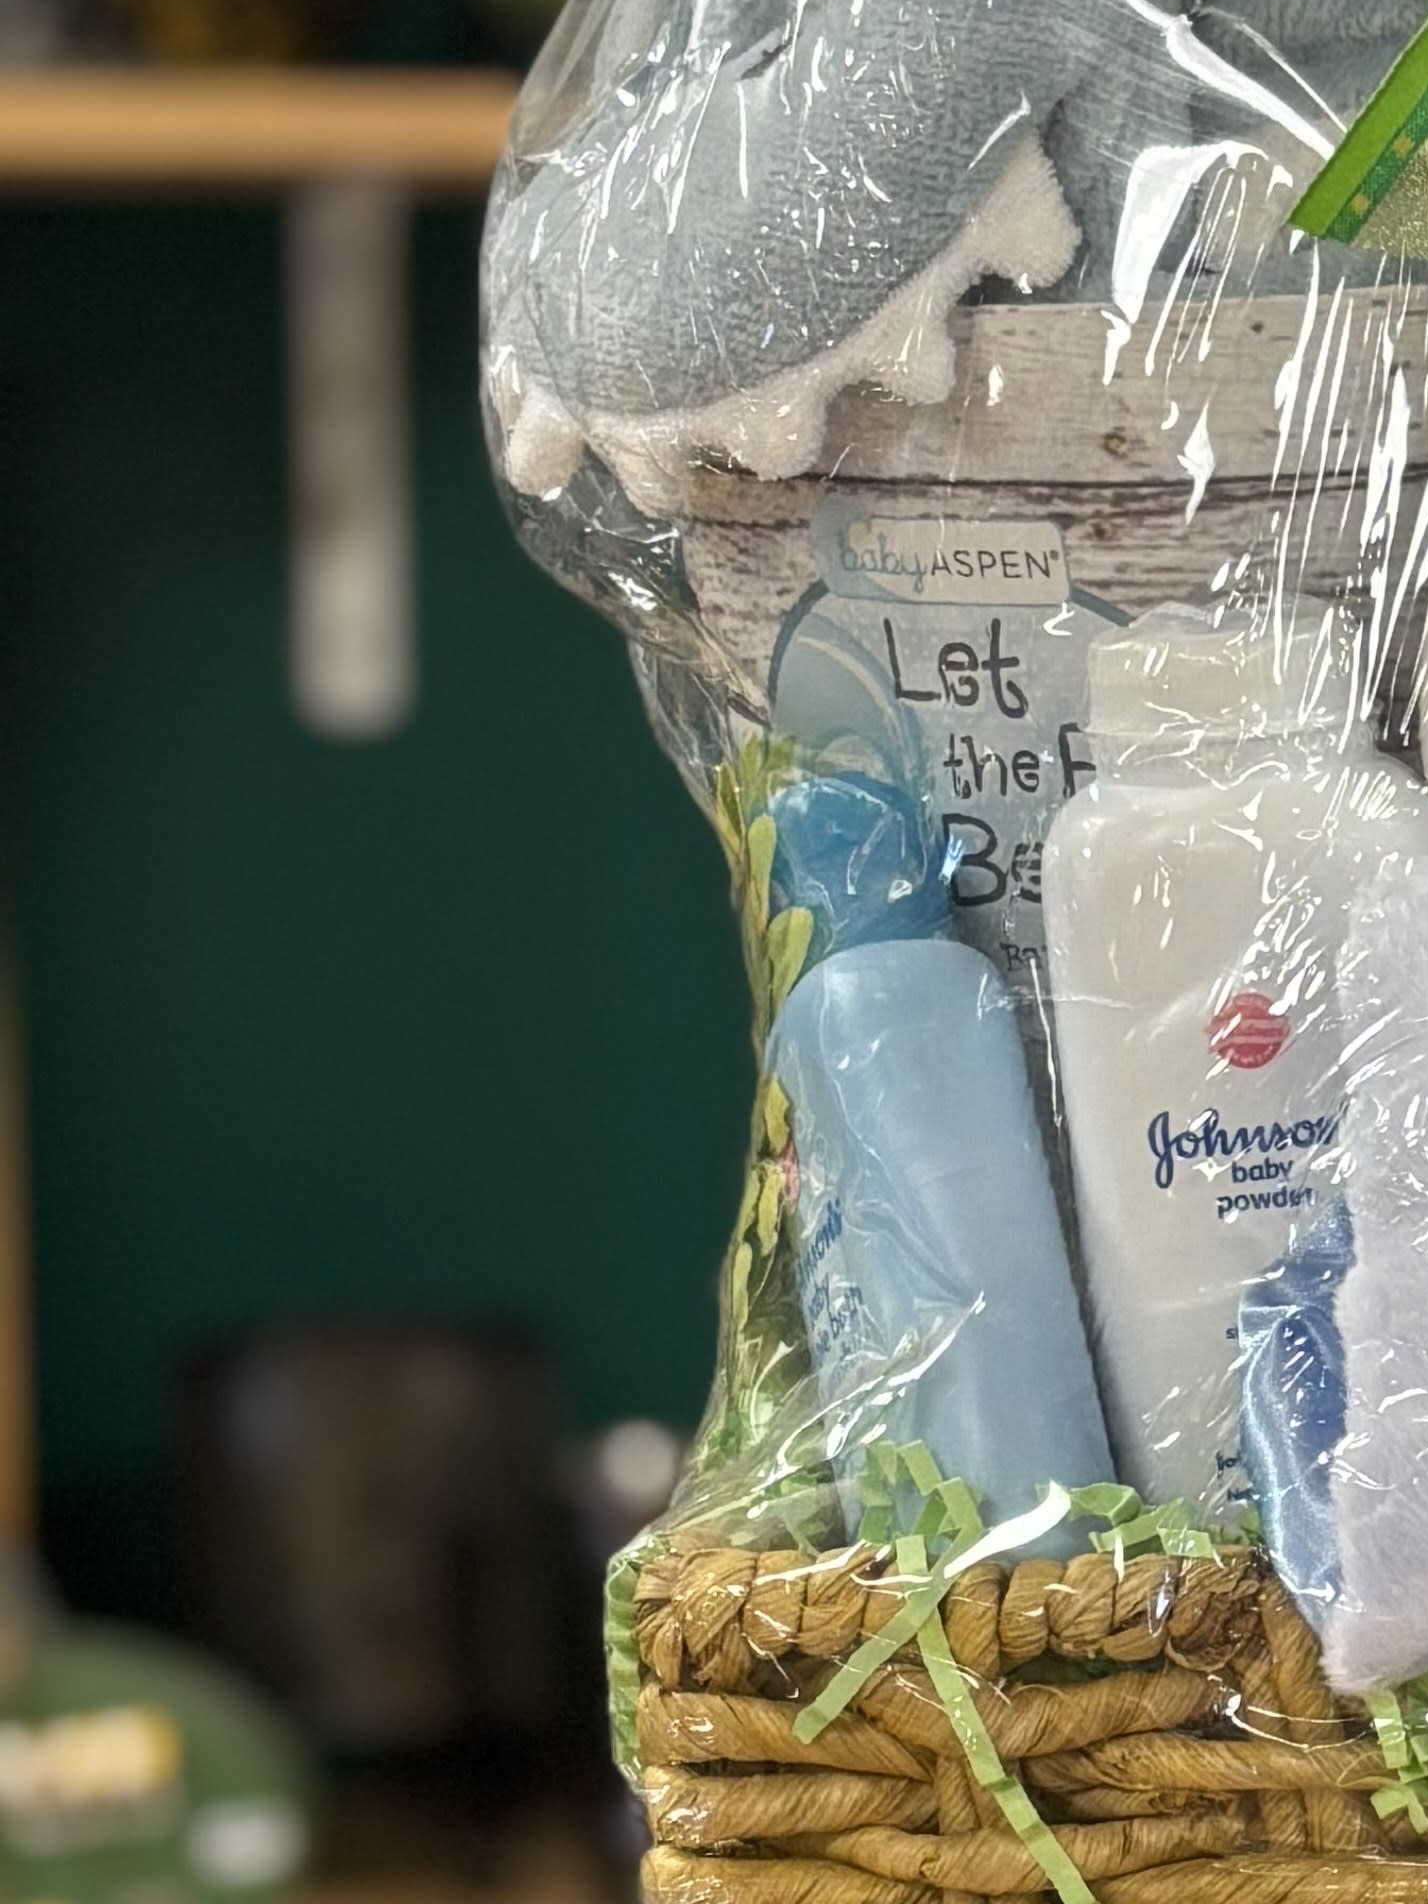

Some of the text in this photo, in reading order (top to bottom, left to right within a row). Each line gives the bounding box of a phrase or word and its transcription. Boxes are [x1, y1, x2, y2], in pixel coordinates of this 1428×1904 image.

[838, 532, 927, 593] baby
[883, 617, 1029, 719] Let
[943, 733, 1040, 799] the
[1232, 1157, 1294, 1184] baby
[1217, 1187, 1315, 1219] powder
